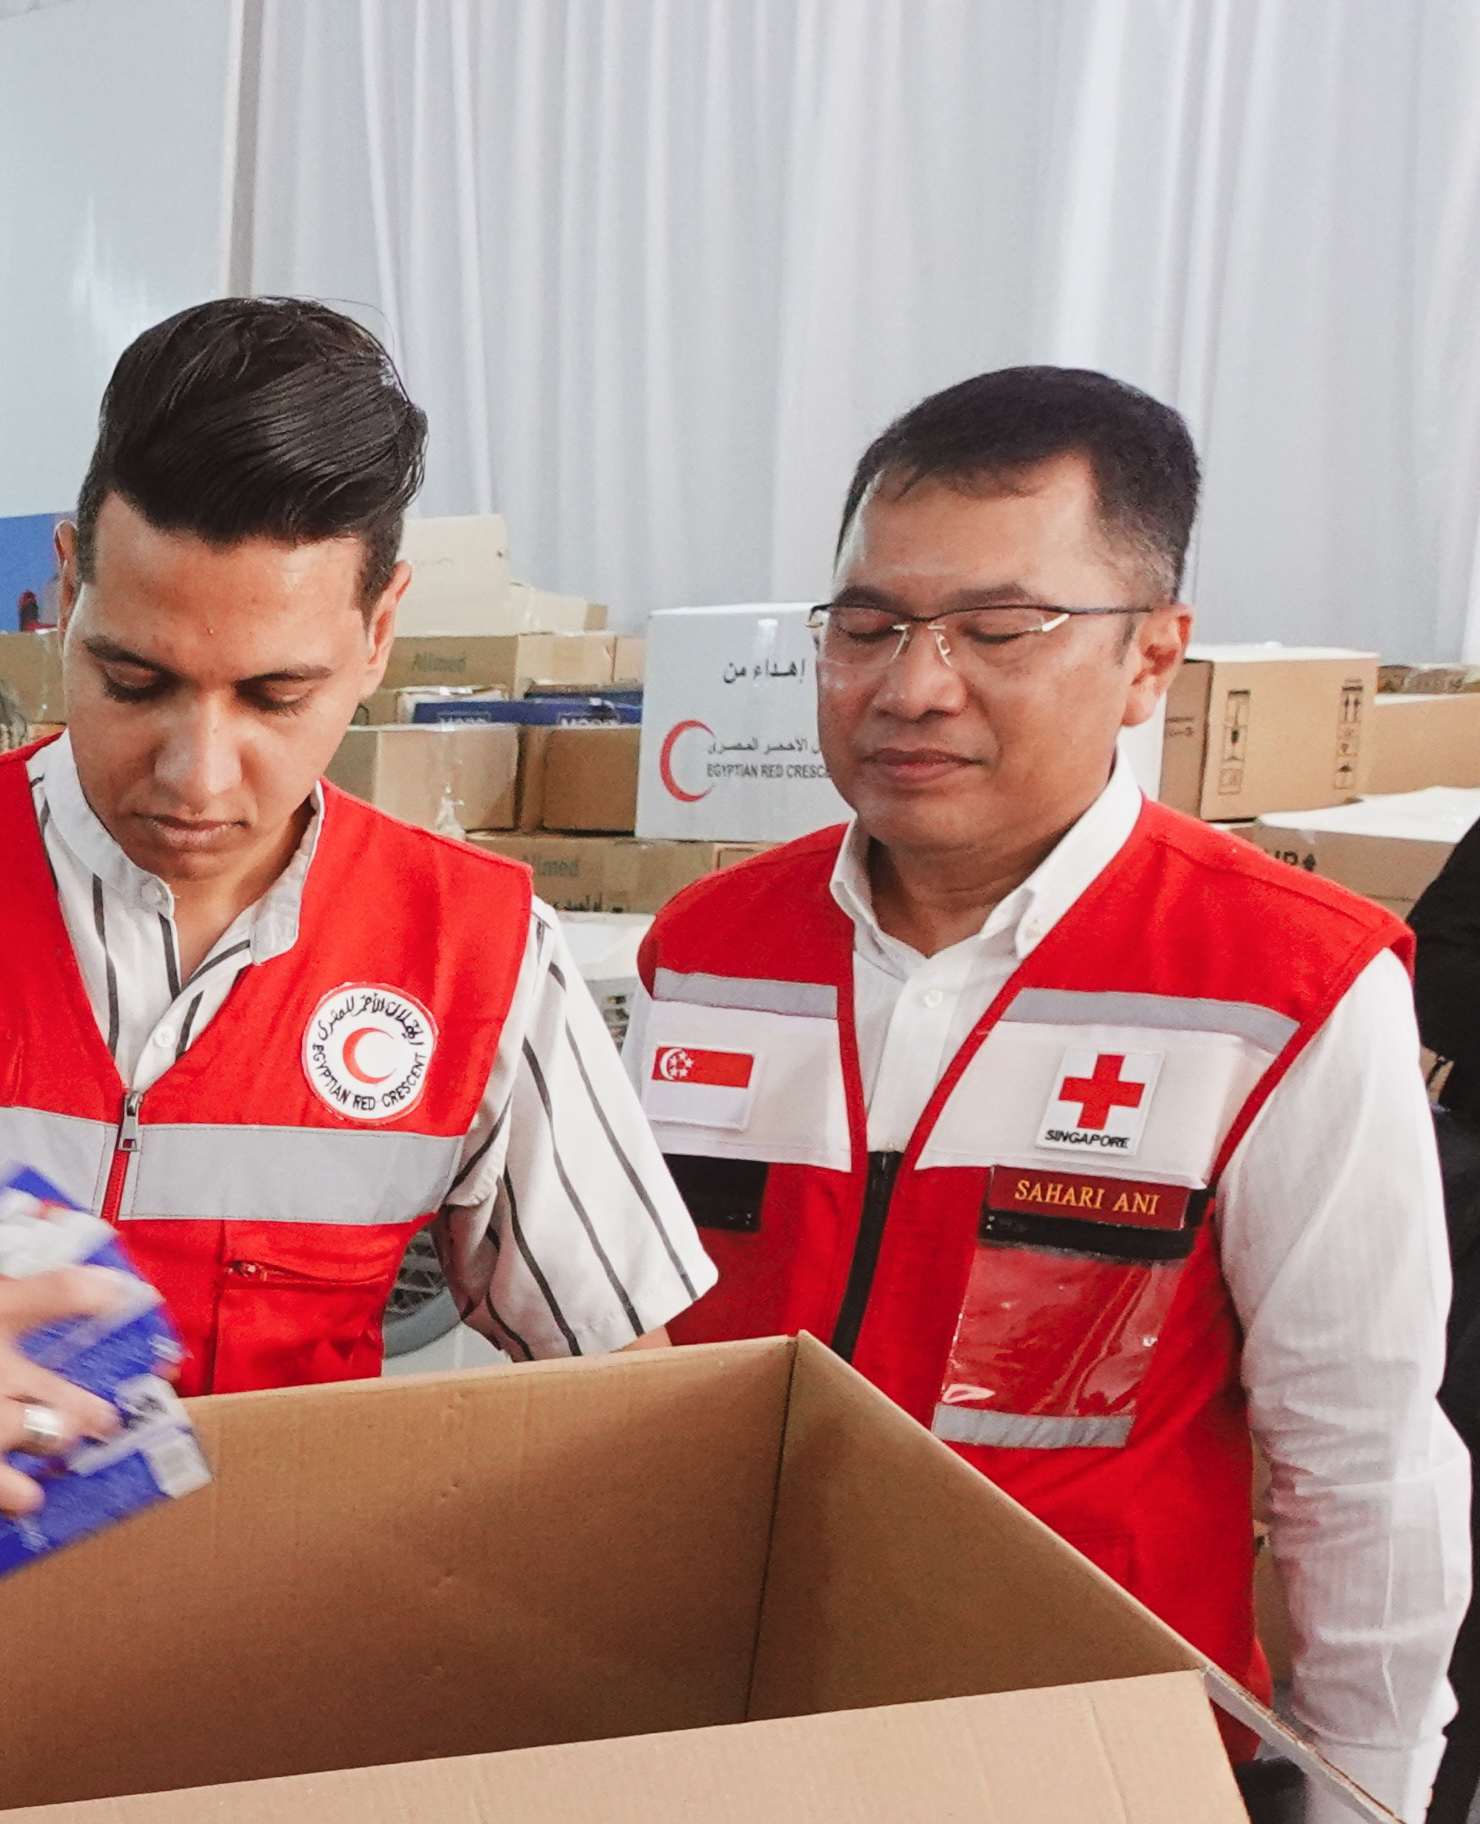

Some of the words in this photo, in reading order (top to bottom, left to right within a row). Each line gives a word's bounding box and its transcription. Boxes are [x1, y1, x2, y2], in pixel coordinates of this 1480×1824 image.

[723, 659, 748, 686] من
[706, 763, 759, 780] EGYPTIAN
[761, 763, 784, 780] RED
[312, 1044, 351, 1105] EGYPTIAN
[352, 1094, 377, 1111] RED
[382, 1052, 427, 1108] CRESCENT
[1044, 1129, 1130, 1149] SINGAPORE
[1014, 1180, 1106, 1210] SAHARI
[1112, 1192, 1161, 1216] ANI
